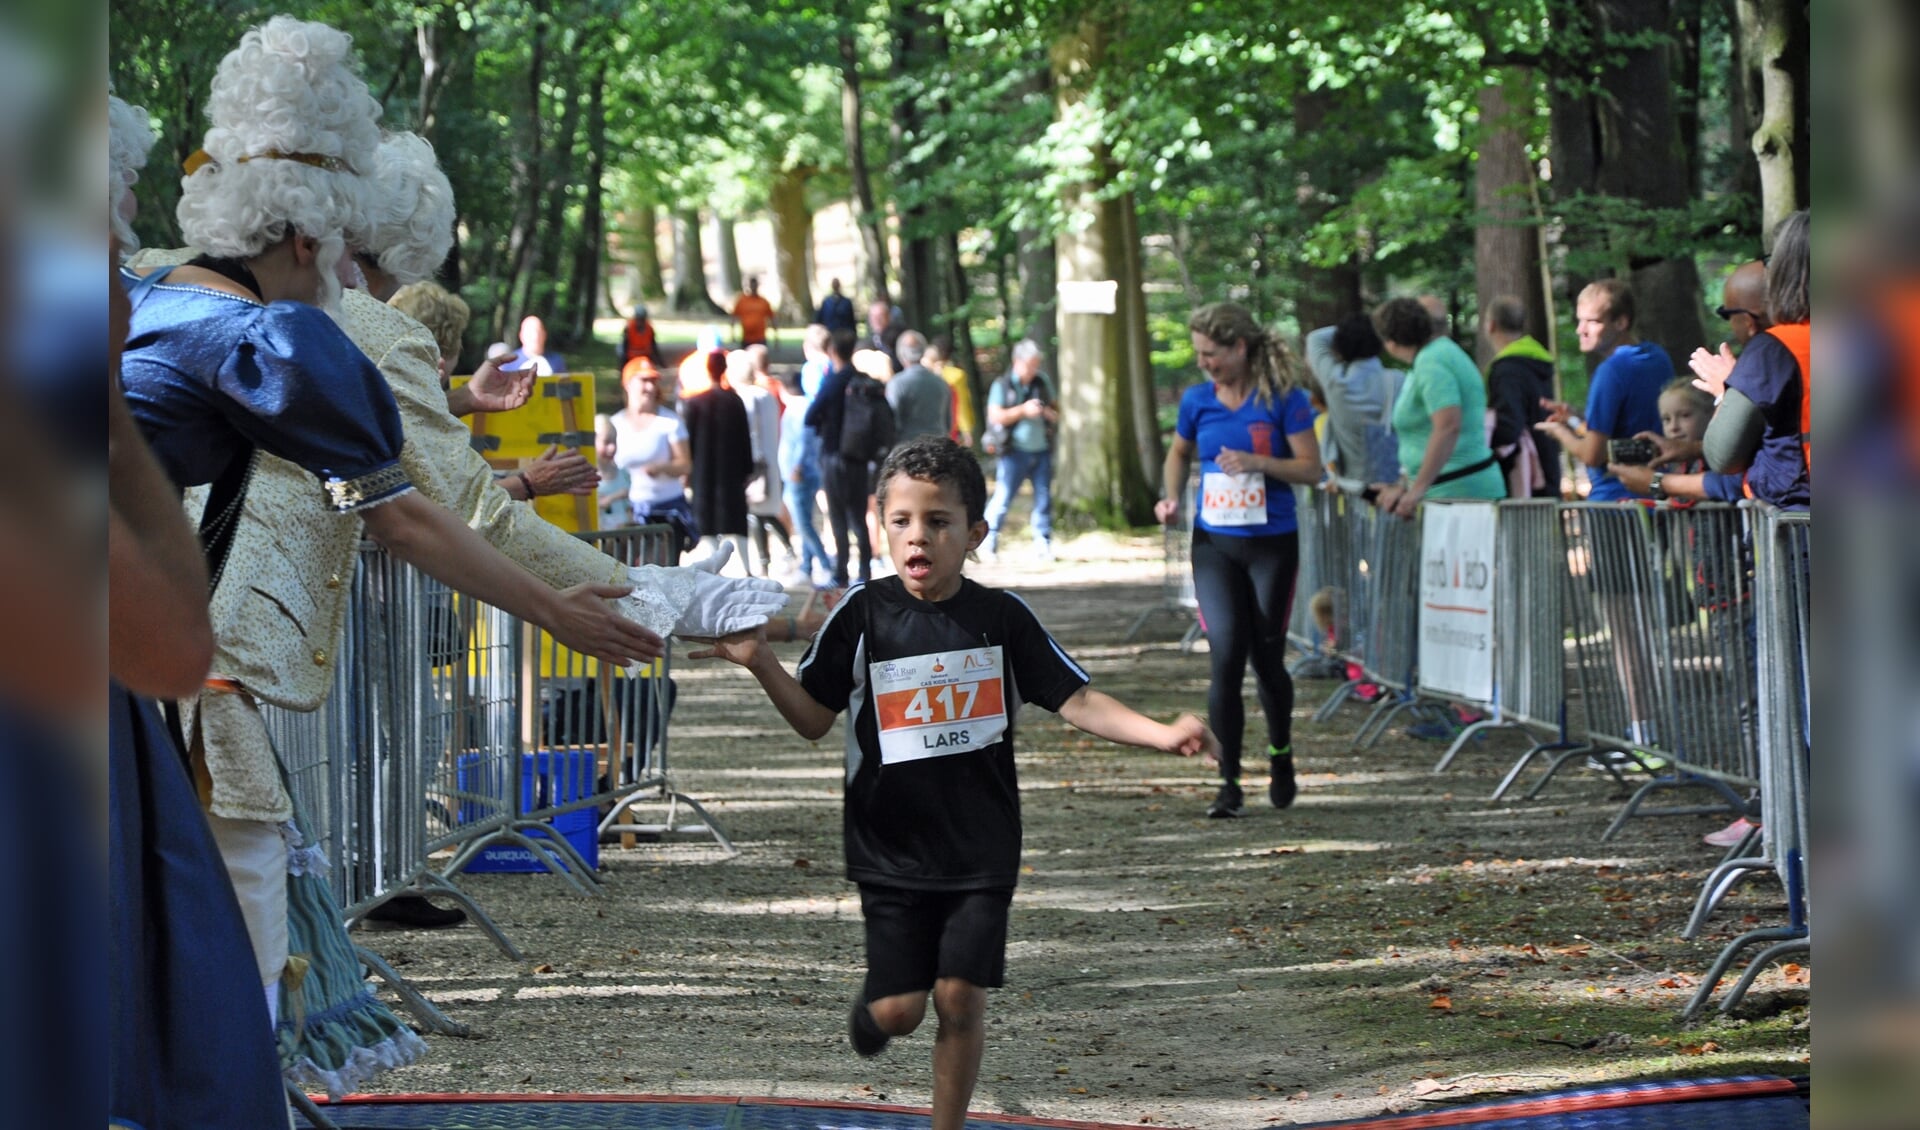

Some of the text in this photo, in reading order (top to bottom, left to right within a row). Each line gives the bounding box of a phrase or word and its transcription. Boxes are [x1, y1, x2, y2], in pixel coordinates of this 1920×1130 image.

[1204, 488, 1264, 508] 7090
[964, 652, 994, 669] ALS
[905, 682, 979, 723] 417
[923, 730, 970, 749] LARS
